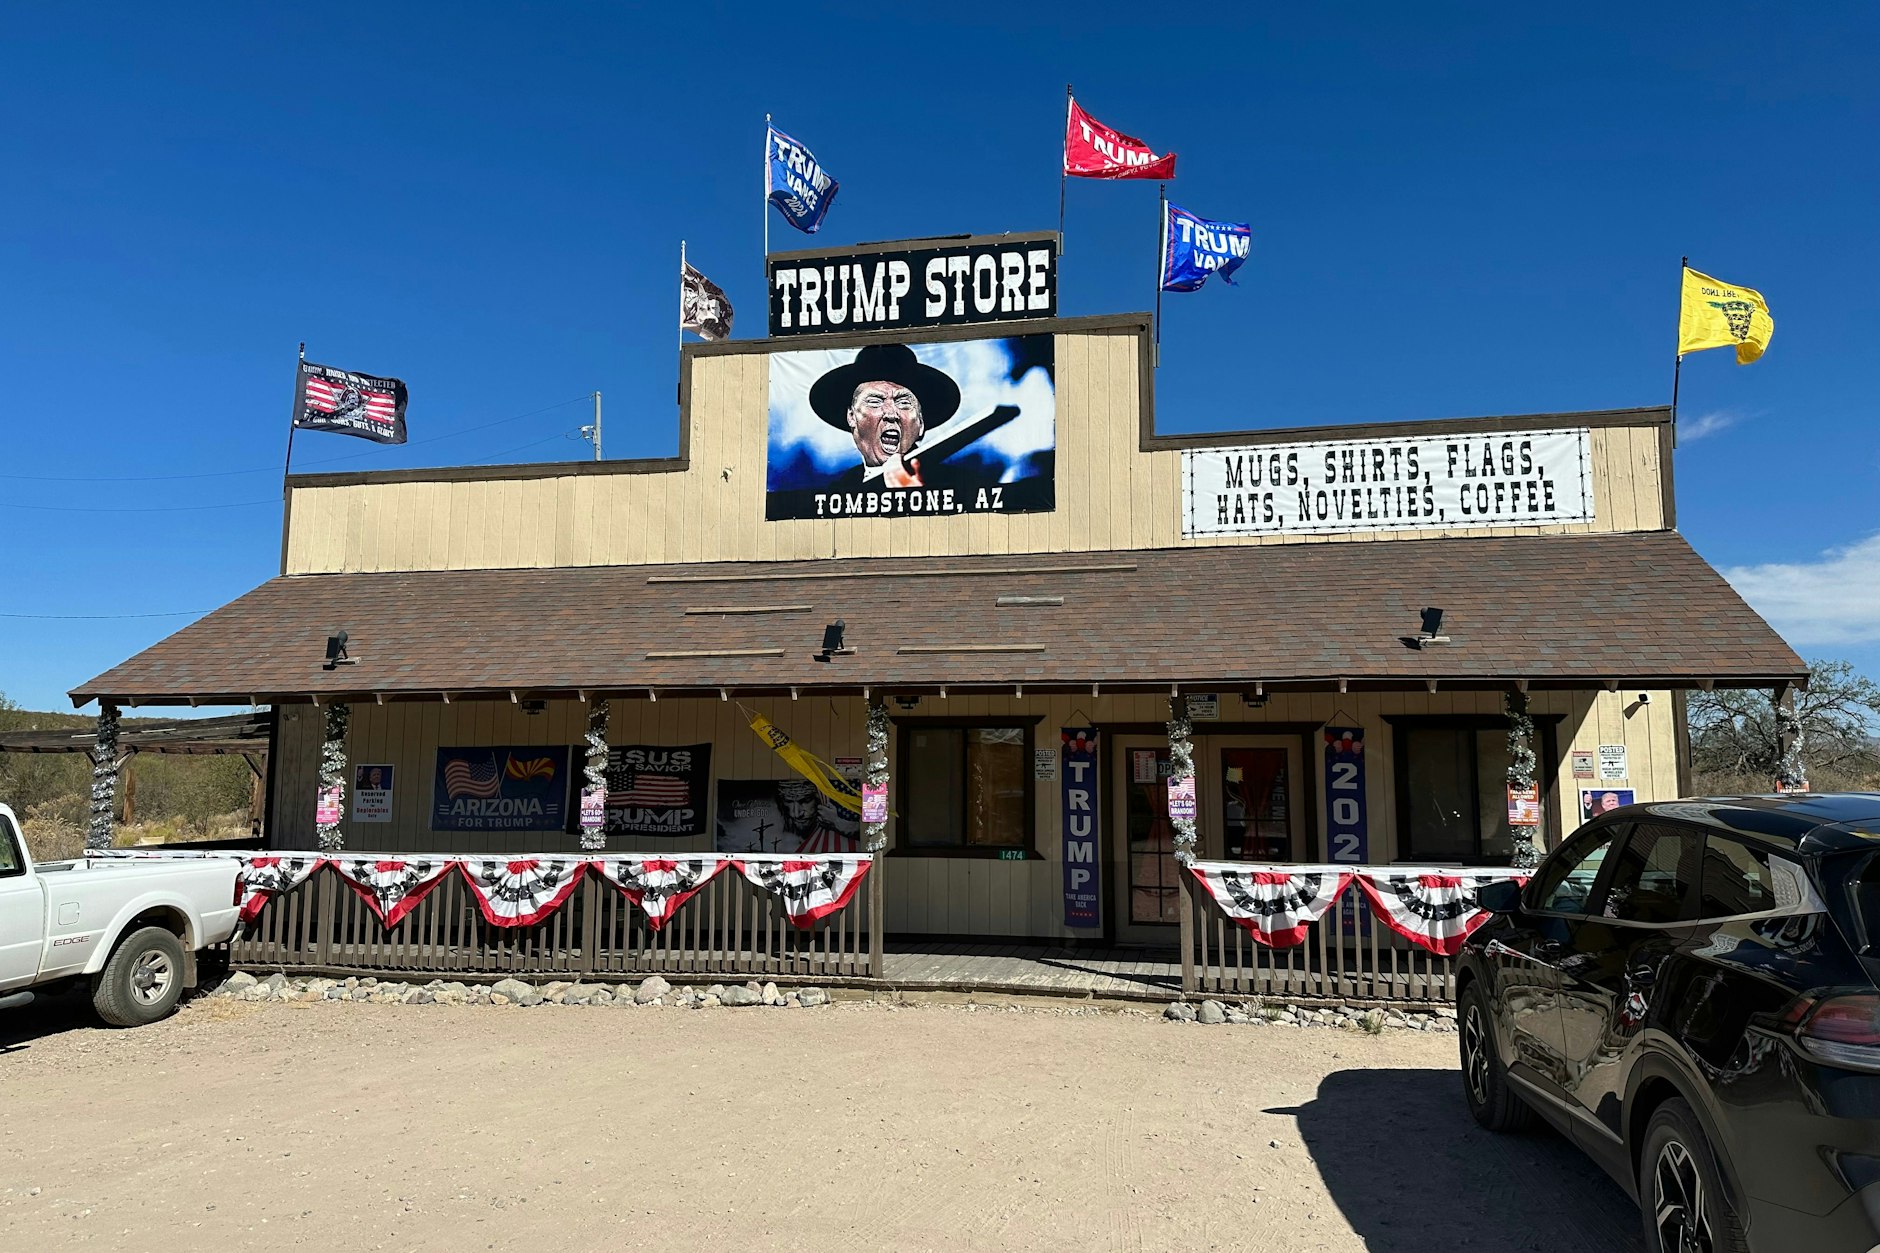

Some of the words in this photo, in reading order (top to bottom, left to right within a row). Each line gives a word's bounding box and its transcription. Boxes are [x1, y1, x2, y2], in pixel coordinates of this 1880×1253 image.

[1177, 218, 1250, 258] TRUM
[1194, 250, 1230, 271] VAN
[776, 260, 910, 328] TRUMP
[926, 249, 1050, 318] STORE
[1225, 452, 1310, 490] MUGS,
[1324, 446, 1430, 484] SHIRTS,
[1446, 440, 1544, 480] FLAGS,
[815, 489, 963, 514] TOMBSTONE,
[975, 487, 1003, 509] AZ
[1217, 492, 1284, 528] HATS,
[1298, 485, 1444, 522] NOVELTIES,
[1460, 480, 1556, 515] COFFEE
[609, 750, 692, 765] ESUS
[635, 764, 692, 772] SAVIOR
[1159, 764, 1175, 774] OPE
[450, 798, 543, 816] ARIZONA
[605, 808, 694, 824] RUMP
[1331, 762, 1360, 861] 202
[458, 817, 482, 827] FOR
[488, 817, 533, 827] TRUMP
[622, 824, 694, 832] PRESIDENT
[1068, 761, 1093, 890] TRUMP
[1002, 851, 1022, 860] 1474
[54, 936, 90, 946] EDGE
